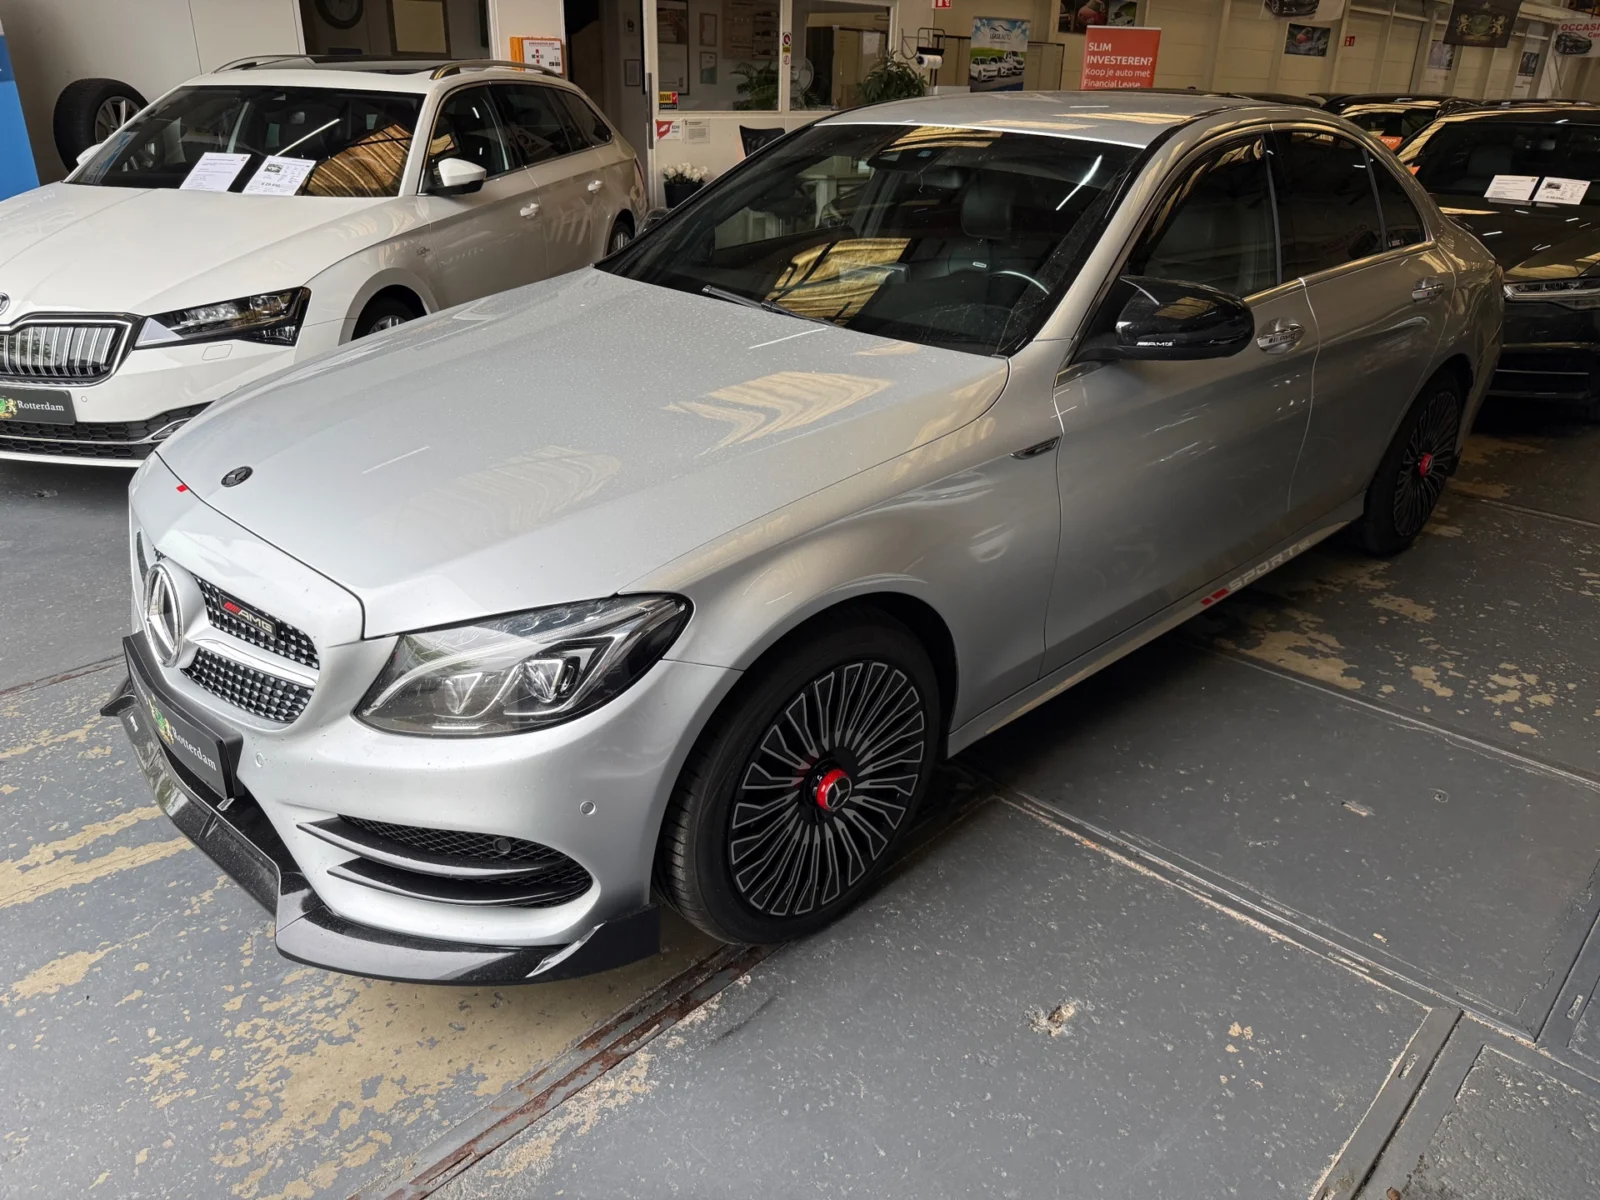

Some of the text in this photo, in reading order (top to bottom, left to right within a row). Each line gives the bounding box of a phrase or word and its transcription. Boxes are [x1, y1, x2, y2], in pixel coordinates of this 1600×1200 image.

[1088, 42, 1112, 52] SLIM
[1086, 55, 1153, 66] INVESTEREN?
[1085, 68, 1105, 77] Koop
[1105, 68, 1114, 77] je
[1115, 69, 1133, 77] auto
[1083, 79, 1141, 88] Financial Lease
[17, 400, 65, 411] Rotterdam
[1228, 544, 1298, 591] SPORT
[238, 609, 273, 633] AMG
[171, 725, 217, 771] Rotterdam
